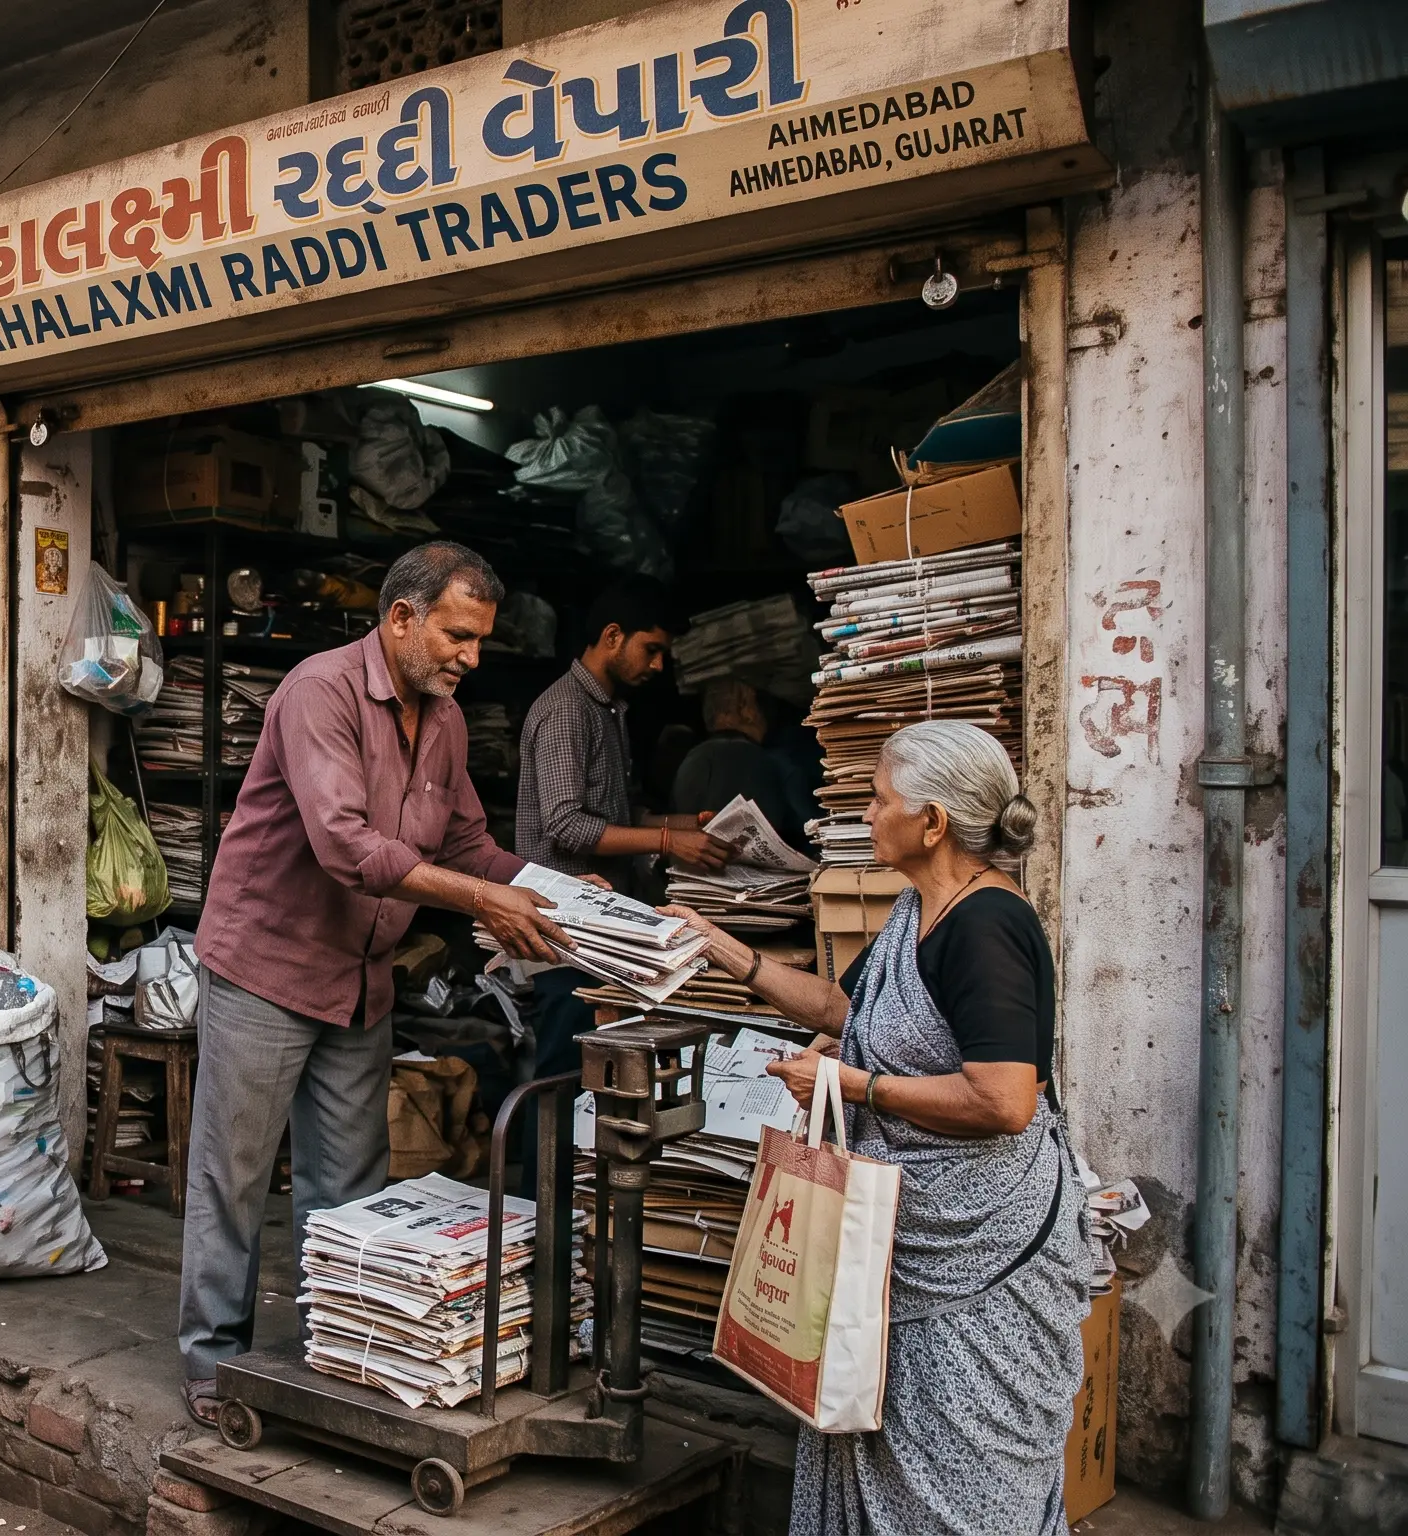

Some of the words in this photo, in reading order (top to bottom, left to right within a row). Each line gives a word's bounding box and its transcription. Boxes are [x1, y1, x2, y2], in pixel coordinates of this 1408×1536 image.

[481, 0, 805, 163] વેપારી
[769, 81, 975, 150] AHMEDABAD
[730, 140, 893, 198] AHMEDABAD,
[895, 107, 1028, 161] GUJARAT
[220, 221, 388, 302] RADDI
[394, 152, 688, 262] TRADERS
